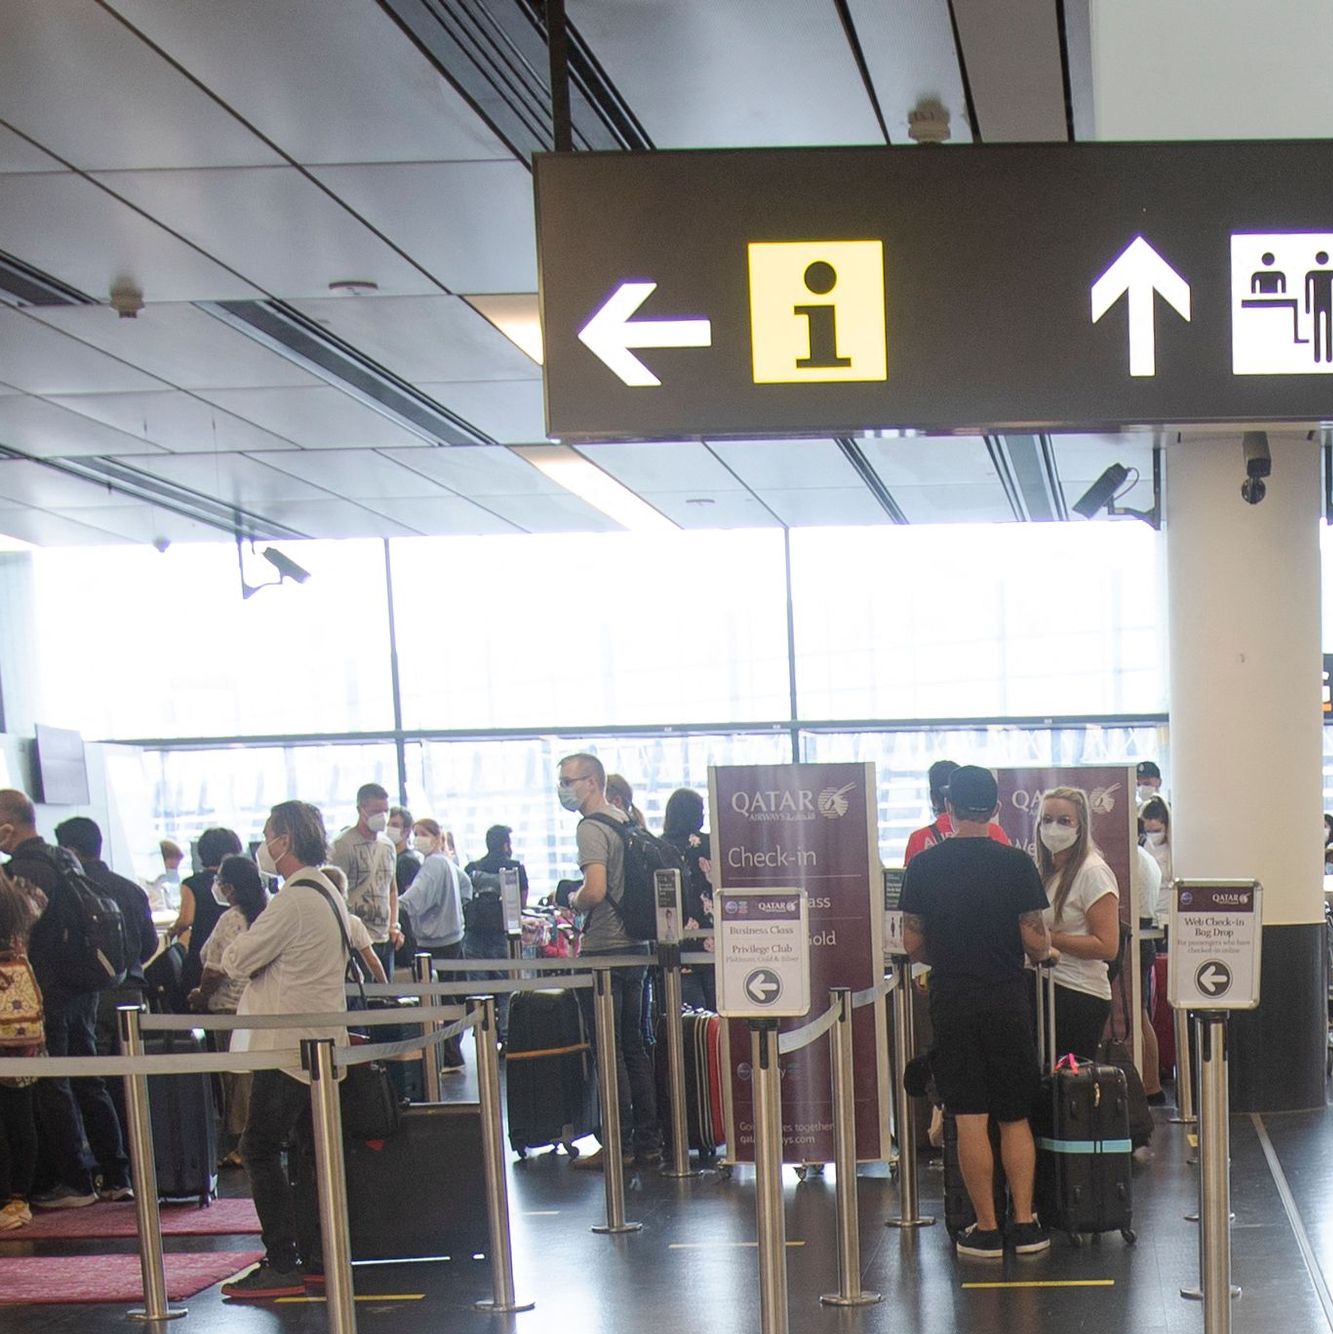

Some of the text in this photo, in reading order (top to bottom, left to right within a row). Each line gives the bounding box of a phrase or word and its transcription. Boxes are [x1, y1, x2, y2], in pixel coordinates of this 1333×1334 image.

[731, 790, 815, 816] QATAR
[728, 845, 817, 868] Check-in
[808, 897, 832, 908] ass
[1212, 893, 1239, 903] QATAR
[758, 901, 786, 912] QATAR
[1205, 916, 1245, 926] Check-in
[729, 925, 794, 936] Business Class
[1213, 928, 1234, 938] Drop
[808, 930, 837, 946] old
[732, 943, 793, 956] Privilege Club
[794, 1120, 835, 1134] together
